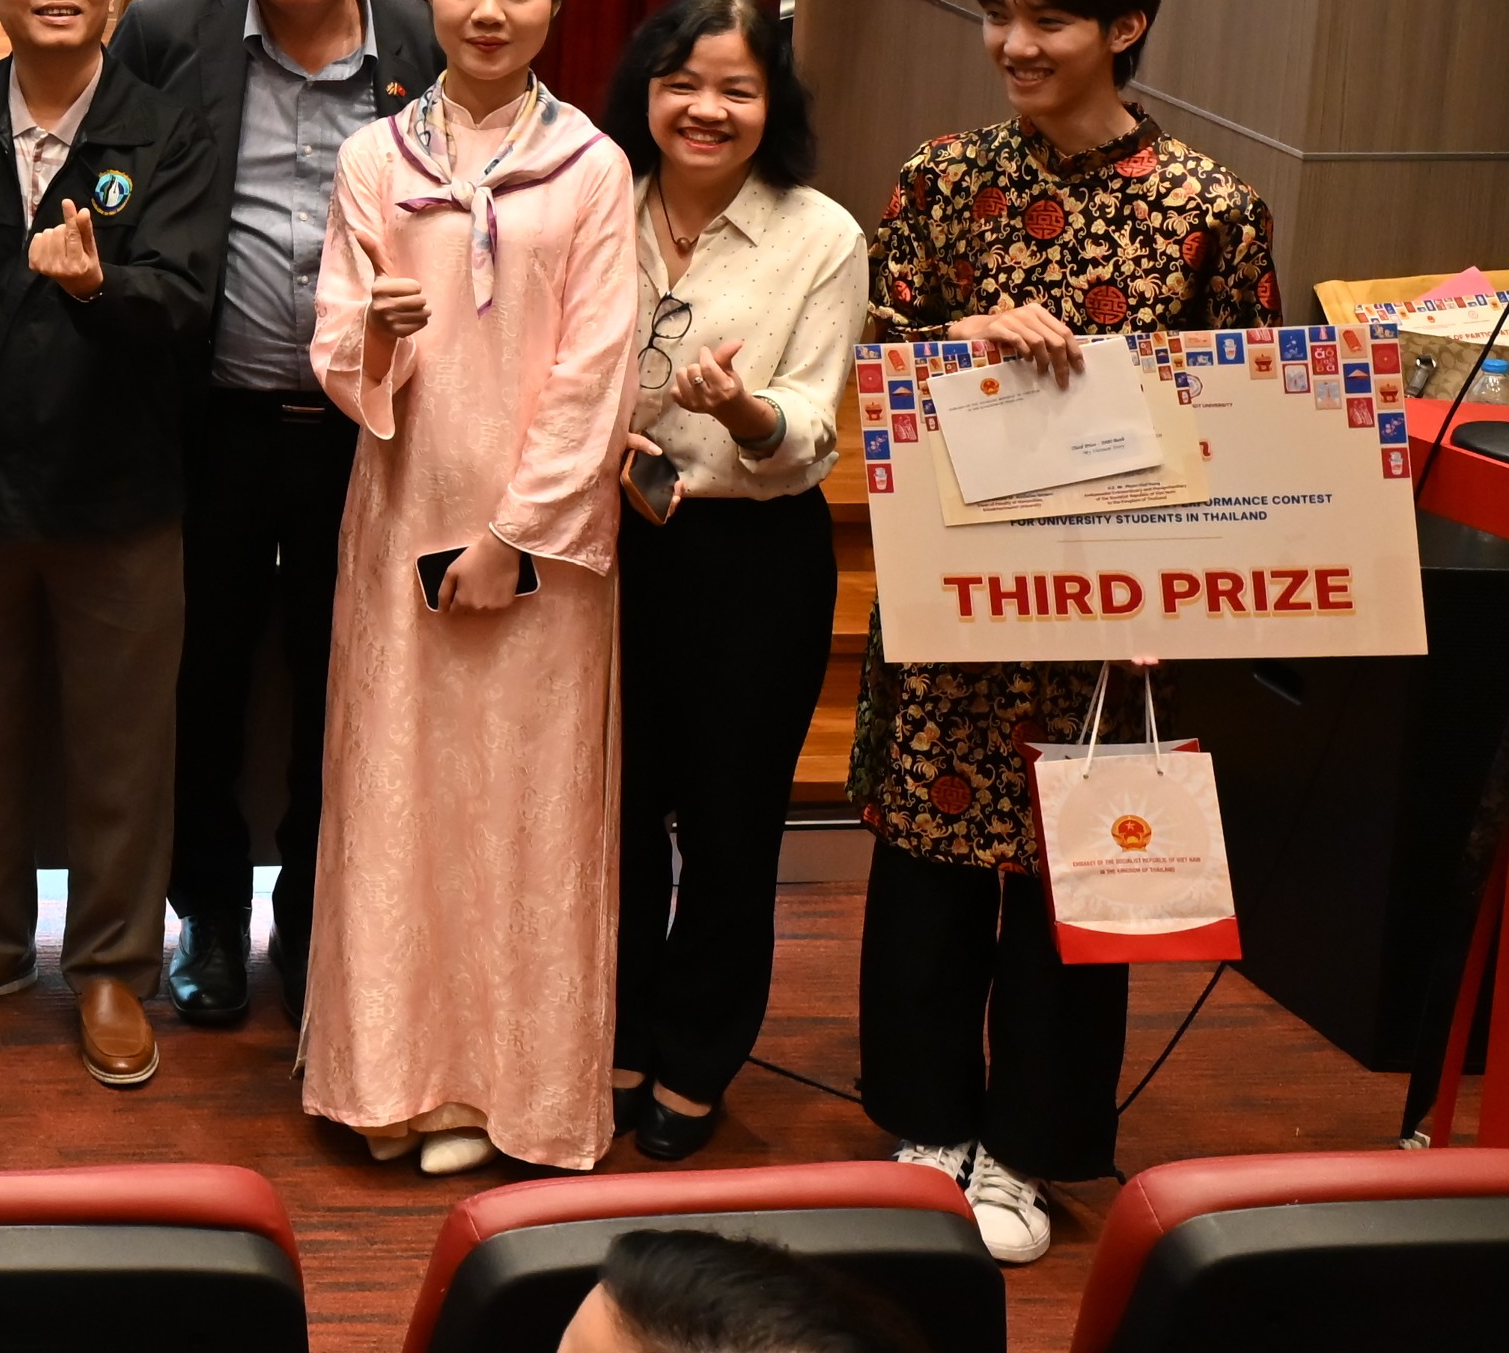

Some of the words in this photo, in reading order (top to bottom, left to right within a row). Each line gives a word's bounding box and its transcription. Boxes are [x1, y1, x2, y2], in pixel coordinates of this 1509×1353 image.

[1271, 493, 1332, 504] CONTEST
[1038, 514, 1112, 526] UNIVERSITY
[1116, 512, 1182, 524] STUDENTS
[1186, 512, 1199, 522] IN
[1202, 510, 1267, 521] THAILAND
[943, 573, 1143, 616] THIRD
[1162, 568, 1354, 613] PRIZE
